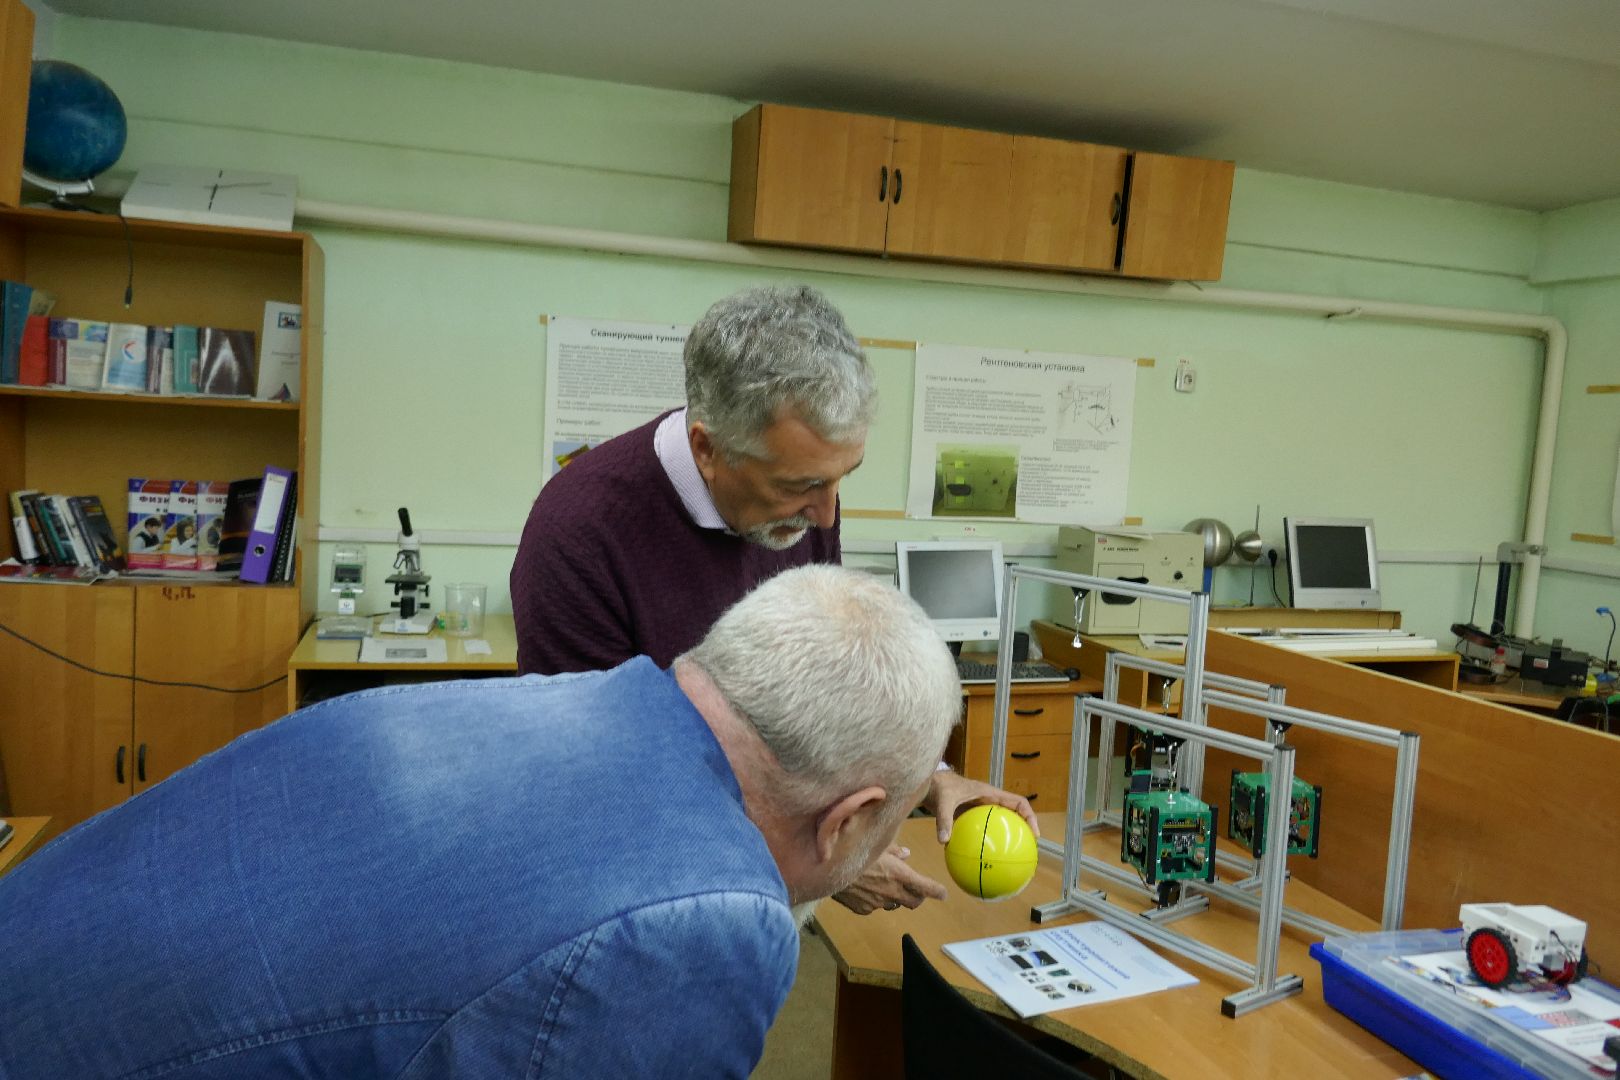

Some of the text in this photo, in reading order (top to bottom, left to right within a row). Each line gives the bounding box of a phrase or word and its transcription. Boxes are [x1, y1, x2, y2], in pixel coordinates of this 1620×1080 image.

[590, 328, 653, 341] Сканирующий
[980, 356, 1086, 374] Рентгеновская установка
